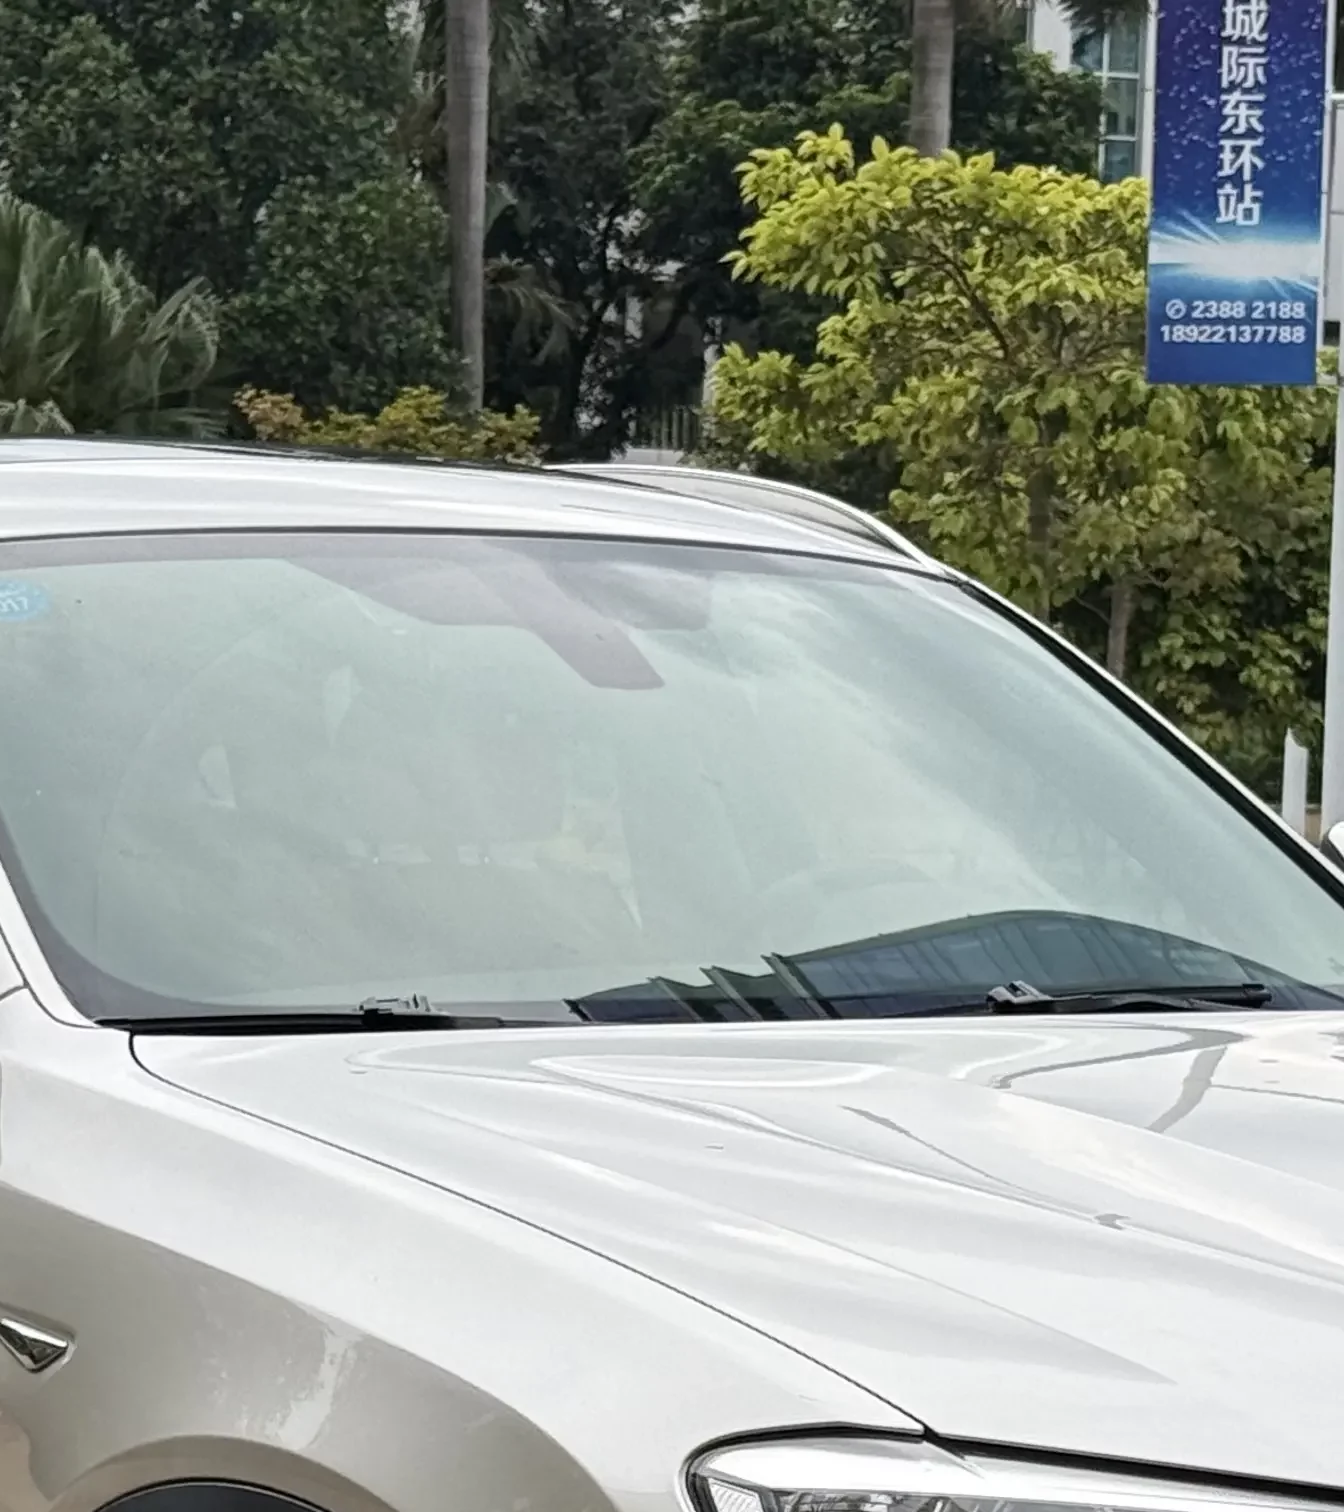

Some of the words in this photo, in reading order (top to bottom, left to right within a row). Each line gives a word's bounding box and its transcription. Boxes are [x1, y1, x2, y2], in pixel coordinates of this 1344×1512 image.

[1215, 0, 1269, 226] 城际东环站
[1191, 300, 1246, 319] 2388
[1251, 300, 1306, 319] 2188
[1160, 324, 1306, 344] 18922137788
